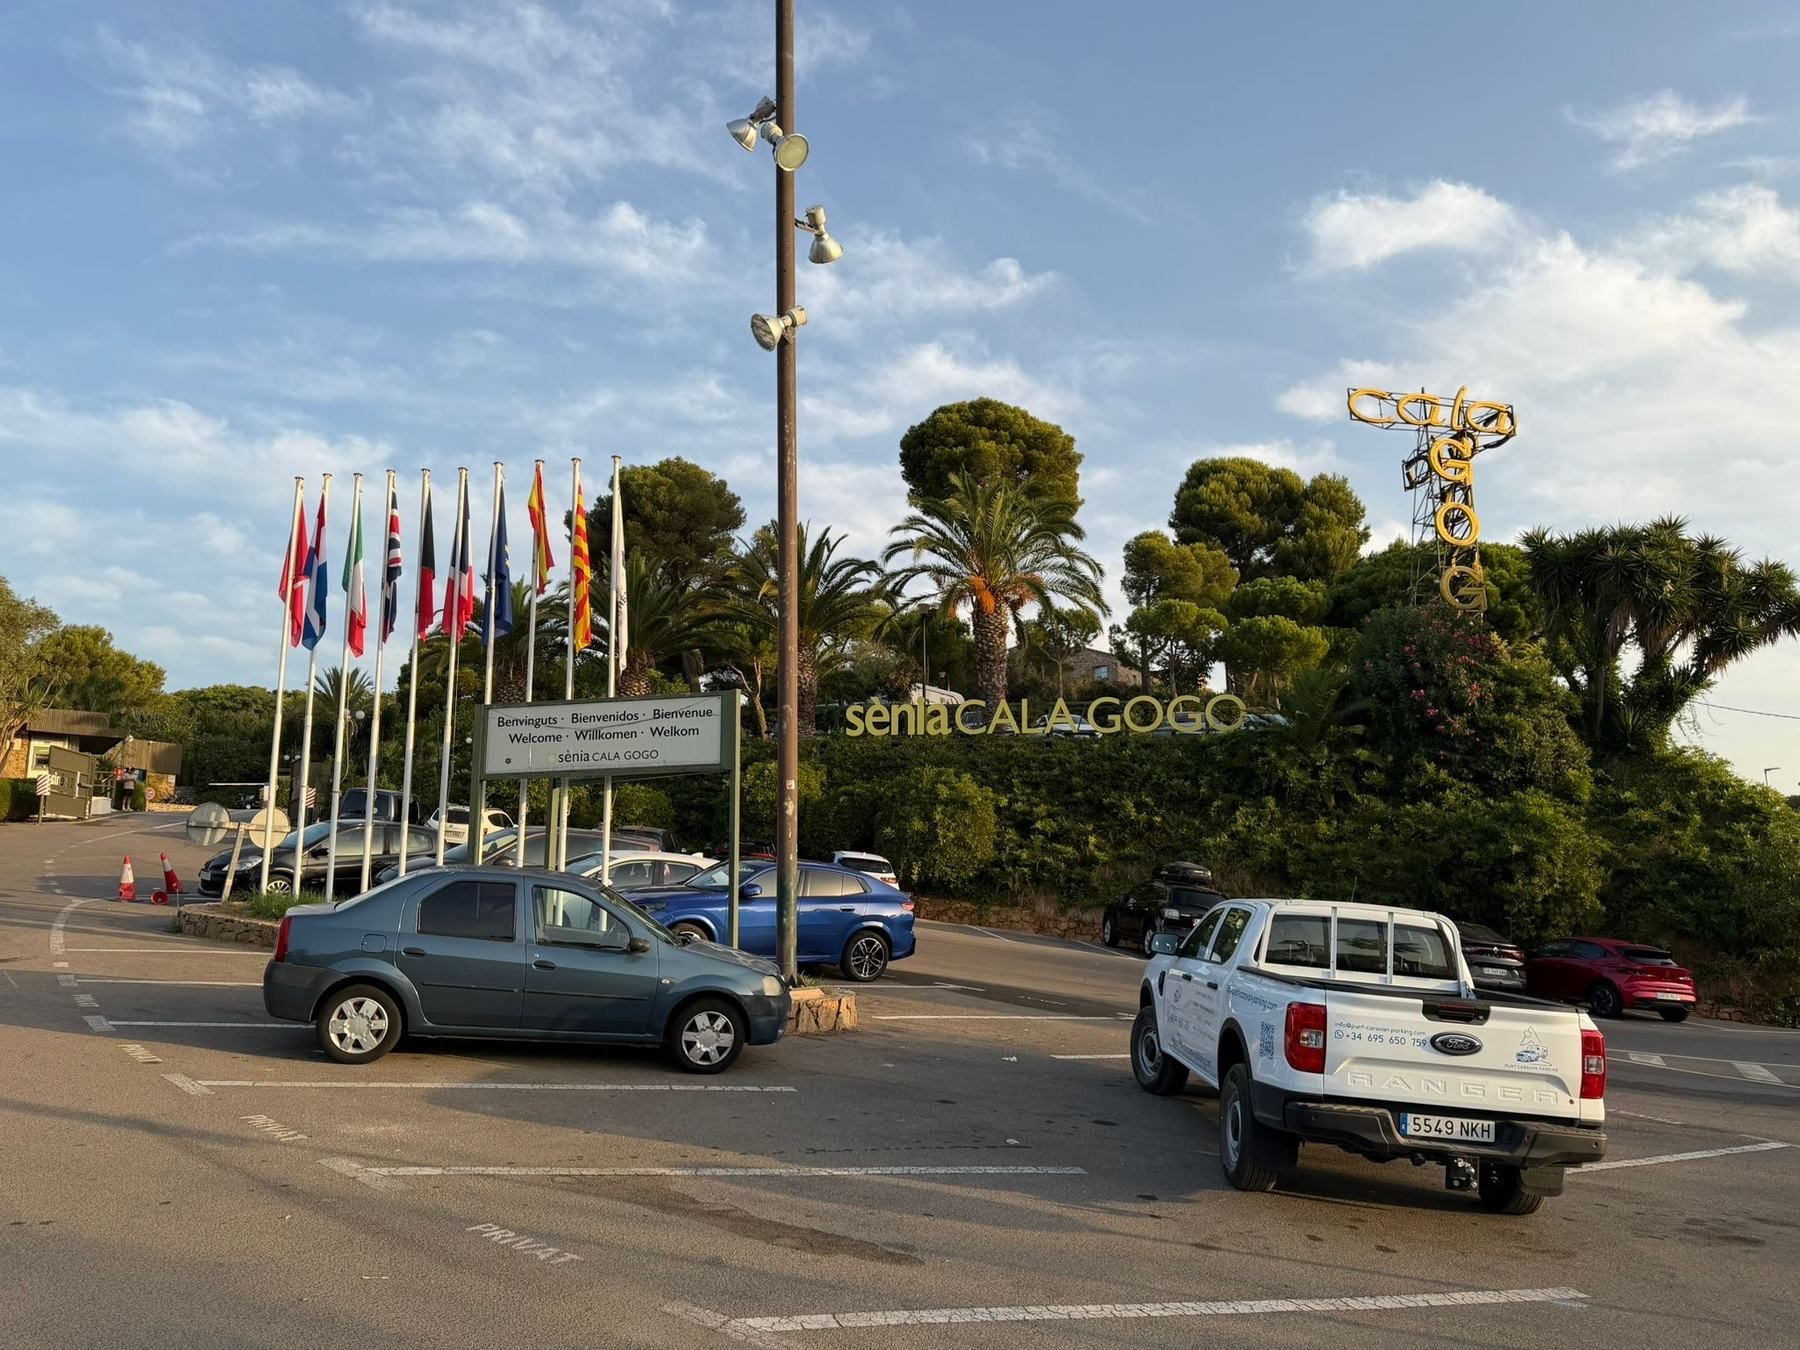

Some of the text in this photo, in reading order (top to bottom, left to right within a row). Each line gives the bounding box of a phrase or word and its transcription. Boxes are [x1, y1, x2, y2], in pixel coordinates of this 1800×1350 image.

[497, 707, 713, 729] Benvinguts Bienvenidos Bienvenue
[845, 694, 1247, 737] sènia CALA GOGO
[508, 732, 563, 744] Welcome
[649, 725, 700, 738] Welkom
[558, 749, 659, 763] sènia CALA GOGO
[1346, 1031, 1428, 1048] +34 695 650 759
[1446, 1038, 1471, 1050] Ford
[1347, 1071, 1559, 1104] RANGER
[1413, 1117, 1454, 1136] 5549
[1460, 1121, 1491, 1139] NKH
[465, 1223, 585, 1264] PRIVAT
